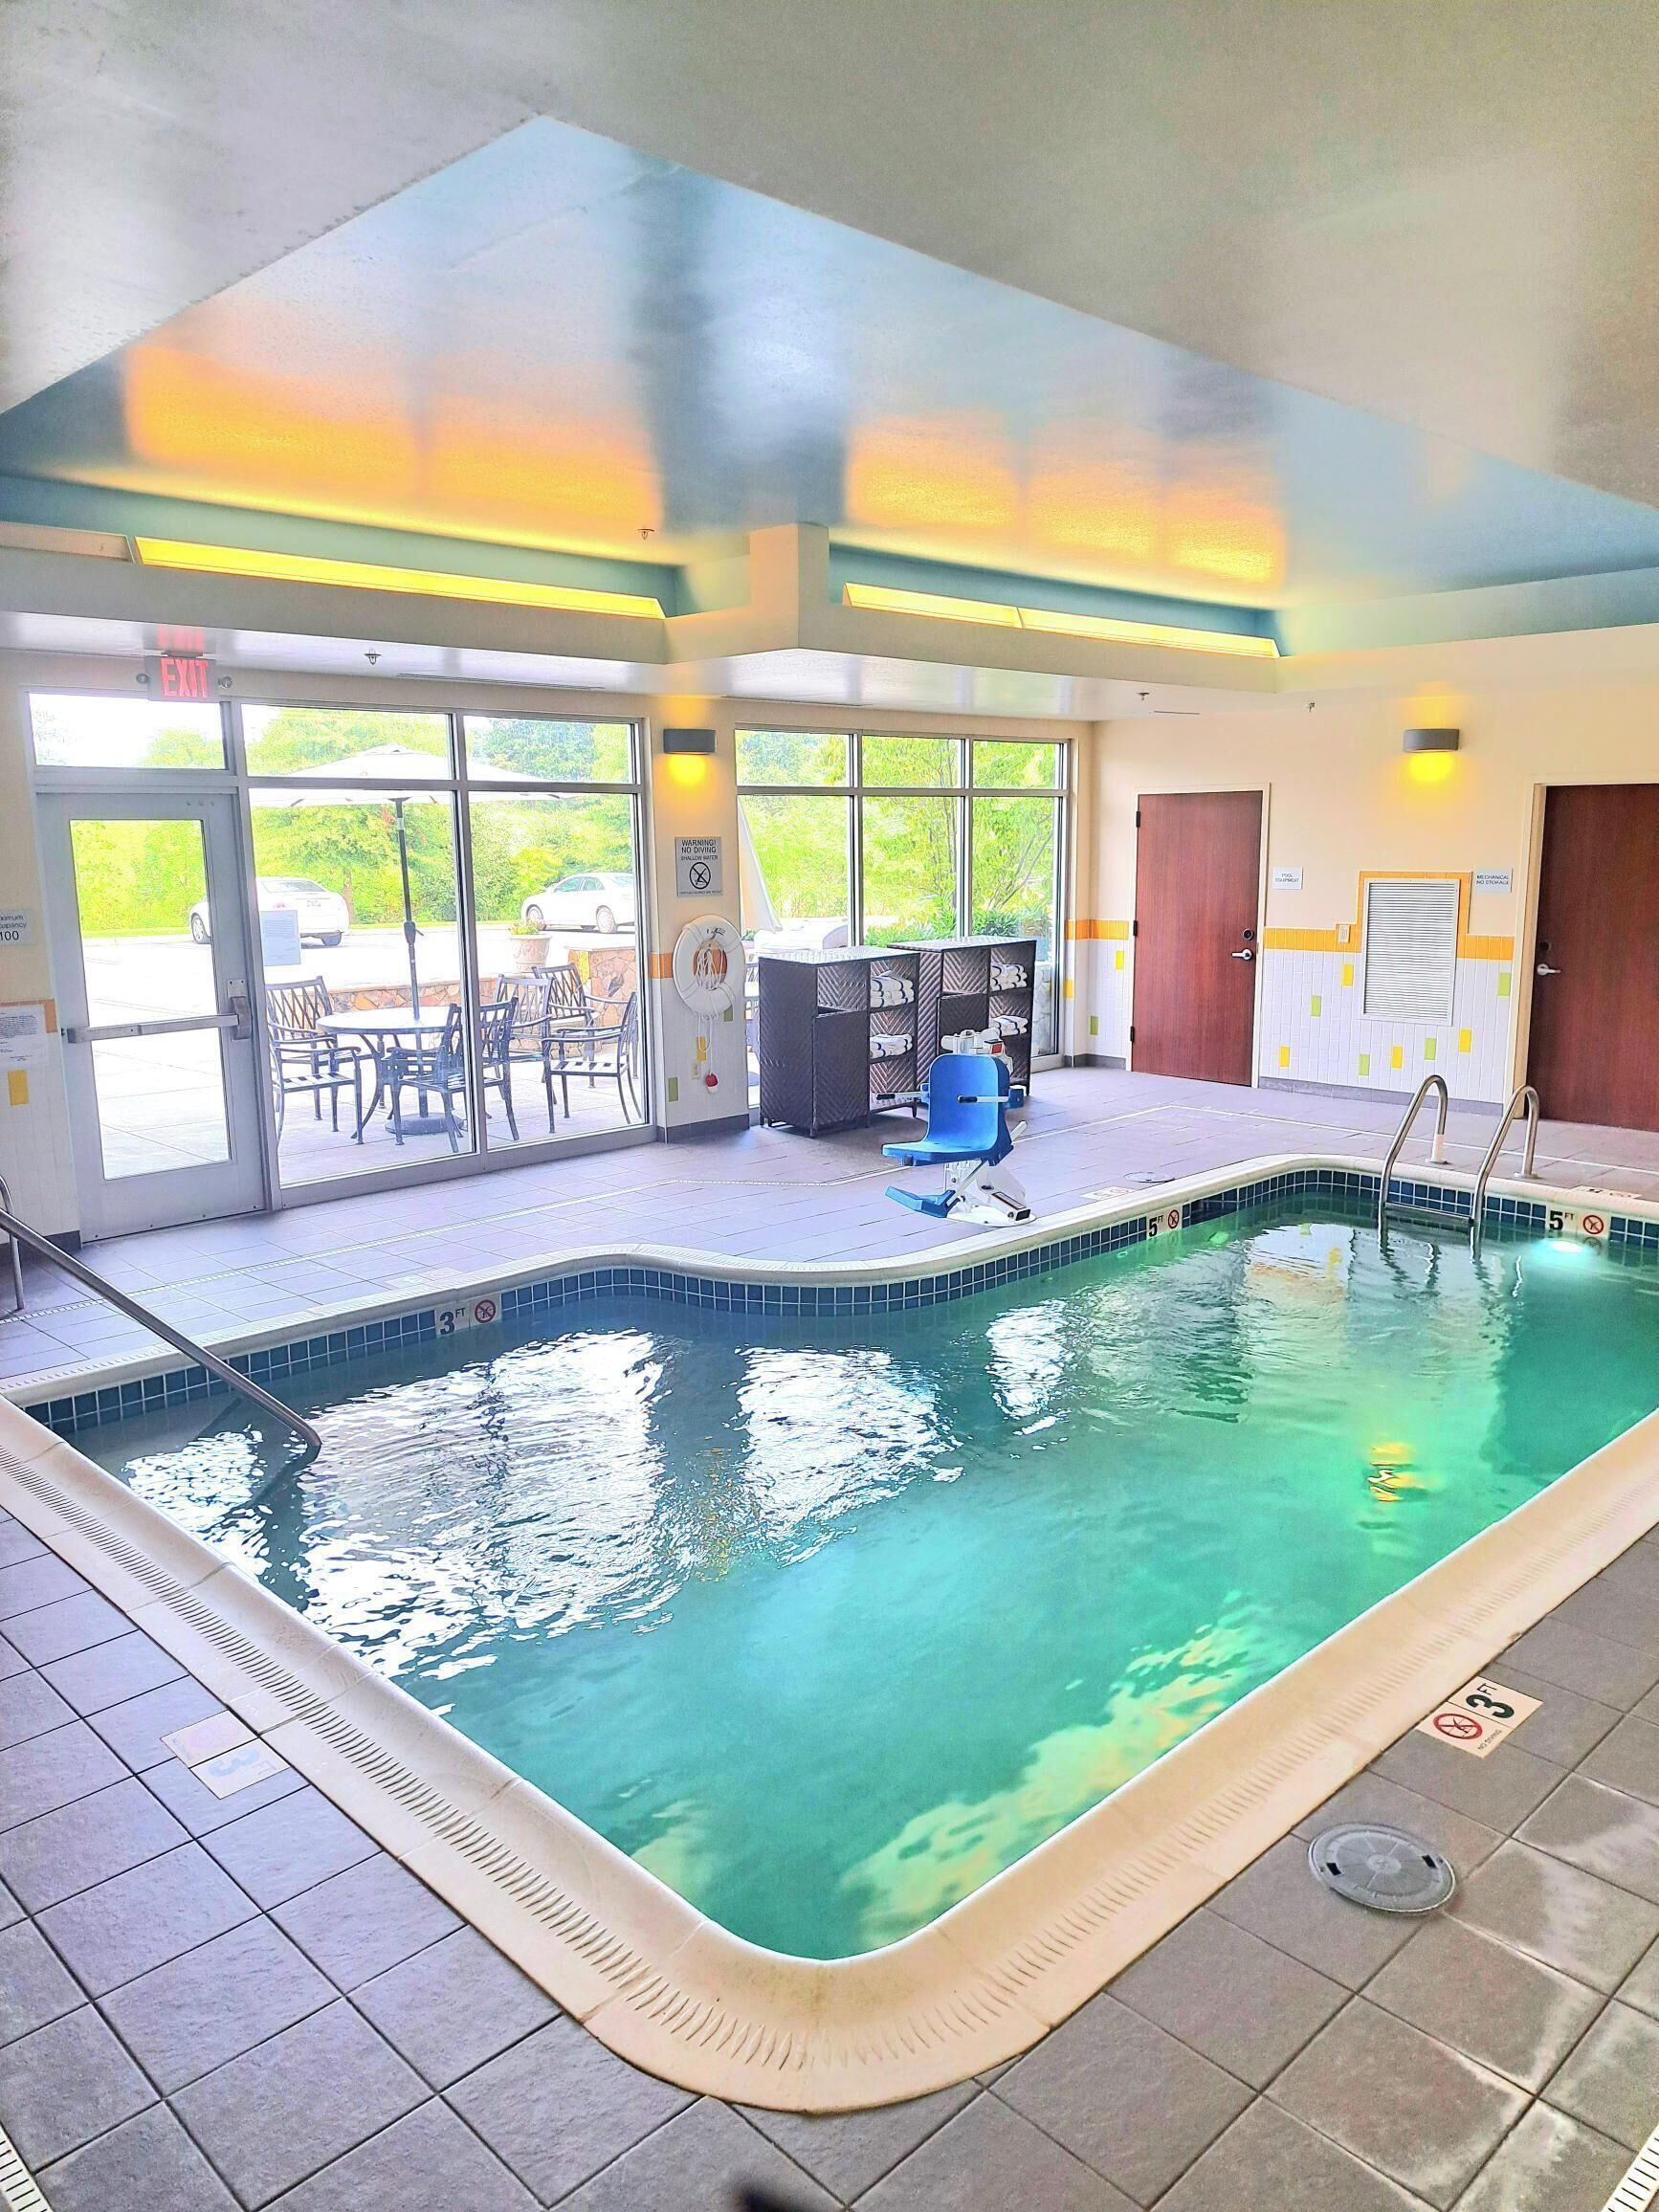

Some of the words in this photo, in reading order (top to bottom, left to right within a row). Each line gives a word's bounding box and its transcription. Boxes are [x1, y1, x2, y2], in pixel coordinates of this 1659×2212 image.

[161, 658, 209, 697] EXIT
[0, 930, 19, 941] 100
[1148, 1216, 1158, 1238] 5
[1158, 1214, 1164, 1224] FT
[1549, 1209, 1564, 1230] 5
[1564, 1211, 1575, 1221] FT
[439, 1311, 455, 1336] 3
[454, 1307, 466, 1318] FT
[1476, 1682, 1497, 1696] FT
[1466, 1693, 1515, 1719] 3
